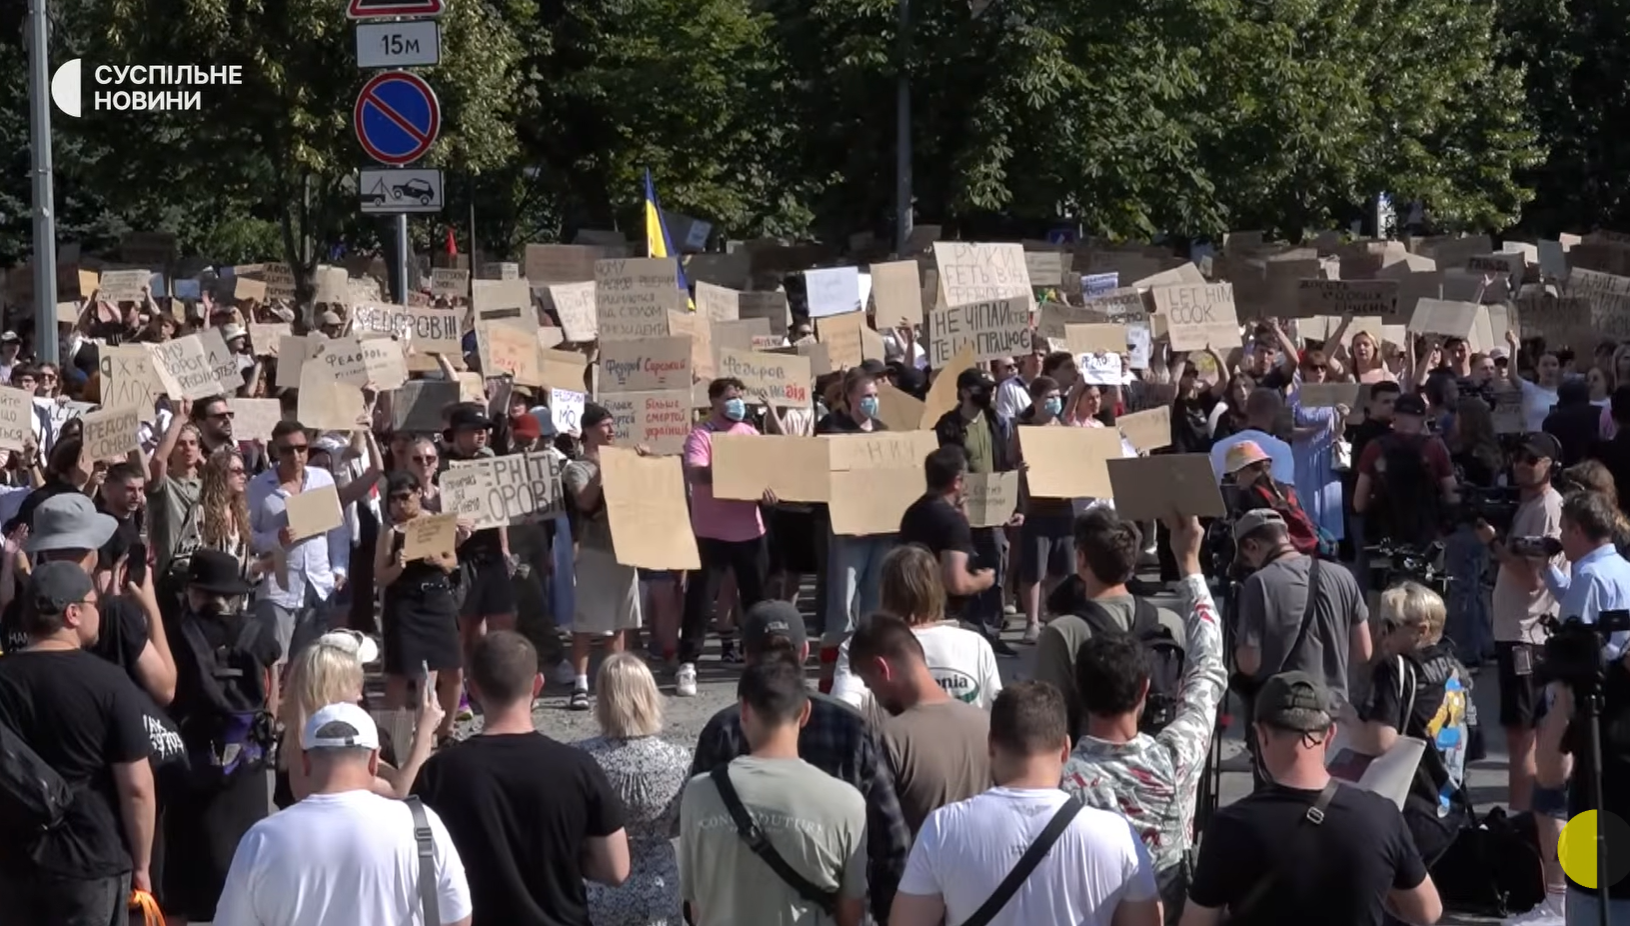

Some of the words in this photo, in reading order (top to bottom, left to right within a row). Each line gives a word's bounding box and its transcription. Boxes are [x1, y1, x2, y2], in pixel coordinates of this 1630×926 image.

[1168, 287, 1199, 307] LET
[934, 308, 961, 338] НЕ
[1170, 304, 1216, 325] COOK
[932, 339, 950, 365] ТЕ
[977, 328, 1031, 355] ПРАЦЮЄ
